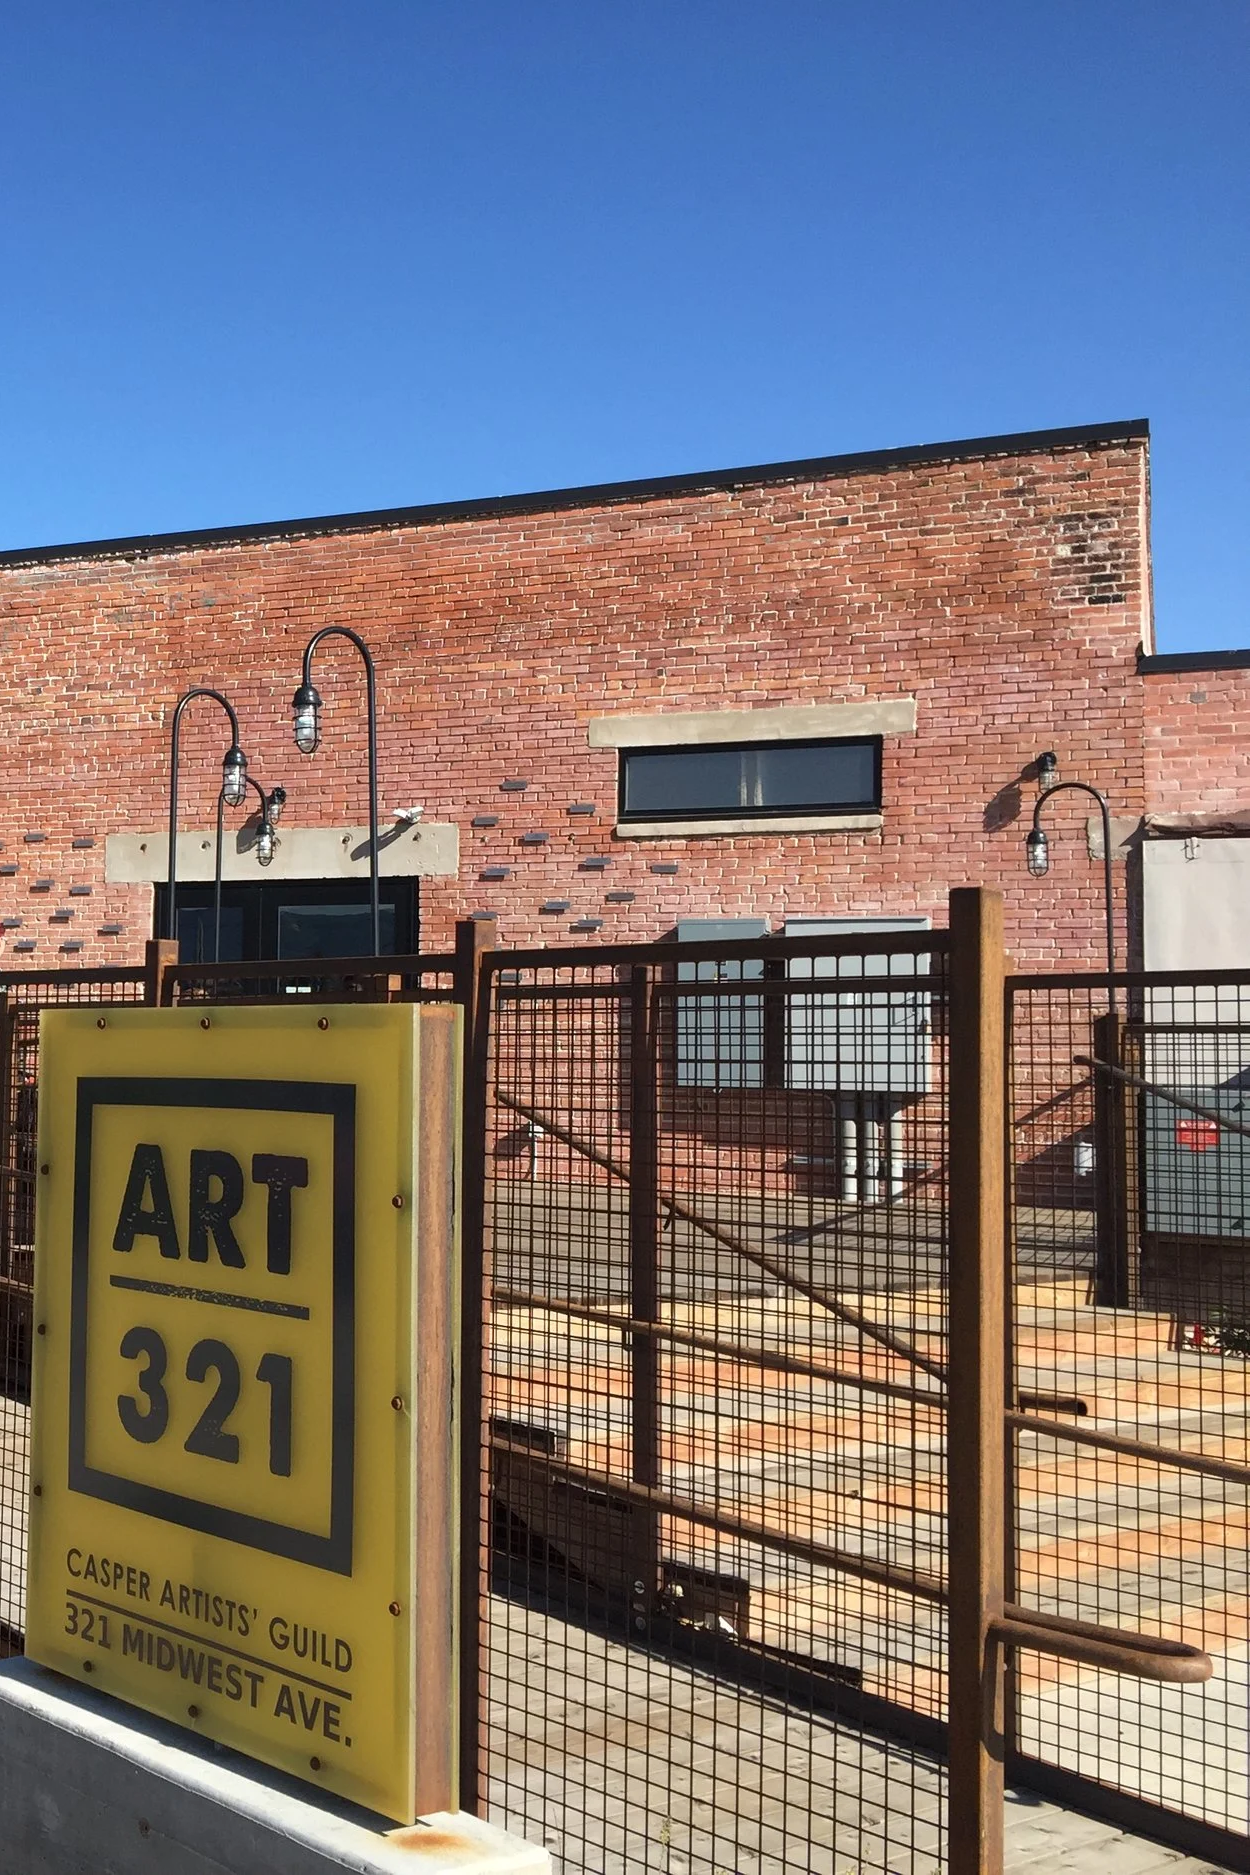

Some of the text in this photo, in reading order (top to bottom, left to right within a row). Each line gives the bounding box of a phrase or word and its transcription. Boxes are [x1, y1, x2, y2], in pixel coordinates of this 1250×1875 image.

[113, 1143, 309, 1276] ART
[116, 1326, 292, 1477] 321
[65, 1602, 352, 1747] 321 MIDWEST AVE.
[67, 1548, 151, 1601] CASPER
[269, 1616, 353, 1673] GUILD
